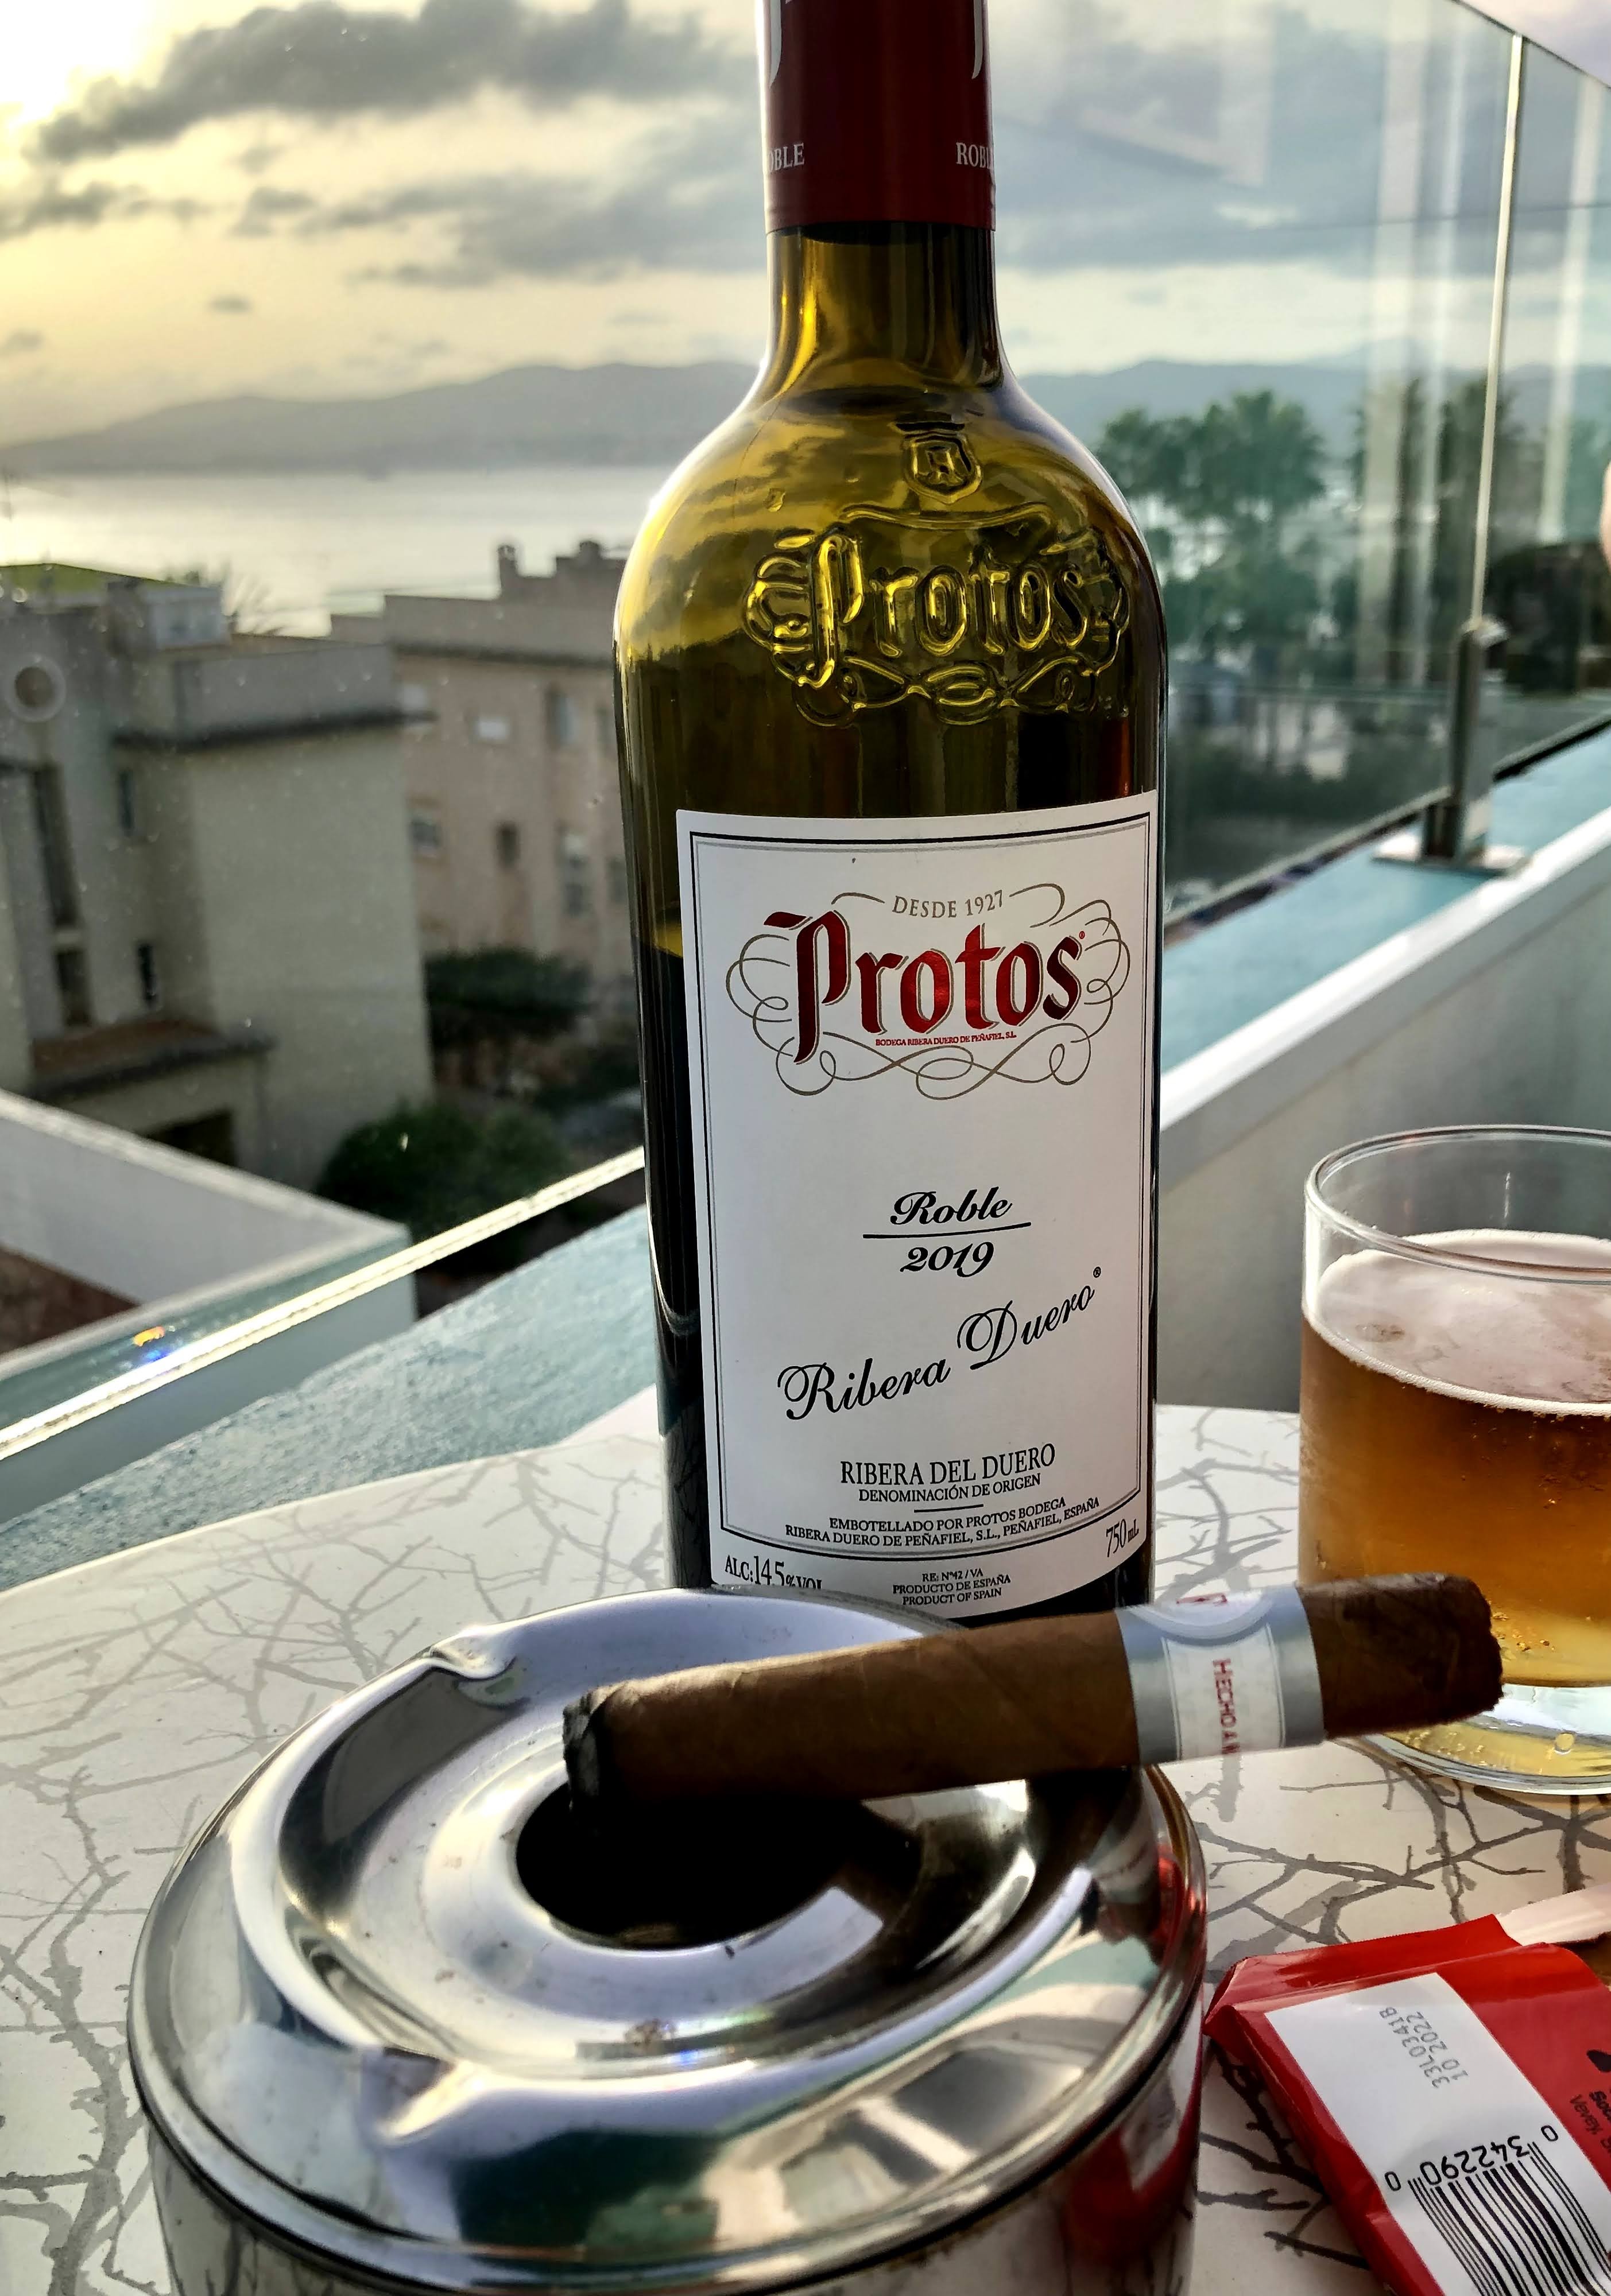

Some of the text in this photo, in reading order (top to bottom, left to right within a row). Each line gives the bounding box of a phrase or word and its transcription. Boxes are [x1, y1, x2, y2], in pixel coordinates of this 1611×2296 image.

[768, 142, 805, 172] OBLE
[775, 531, 1089, 689] Protos
[892, 889, 1002, 918] DESDE 1927
[908, 1037, 932, 1045] RIBERA
[934, 1036, 959, 1044] DUERO
[890, 1186, 1013, 1225] Roble
[900, 1241, 994, 1278] 2019
[777, 1358, 951, 1420] Ribera
[840, 1443, 1056, 1486] RIBERA DEL DUERO
[859, 1473, 1041, 1502] DENOMINACIÓN DE ORIGEN
[785, 1524, 831, 1542] RIBERA
[833, 1532, 880, 1546] DUERO
[882, 1535, 902, 1546] DE
[905, 1532, 973, 1546] PEÑAFIEL,
[1003, 1514, 1062, 1537] PEÑAFIEL,
[1064, 1496, 1100, 1521] ESPAÑA
[829, 1496, 1066, 1532] EMBOTELLADO POR PROTOS BODEGA
[893, 1574, 1011, 1594] PRODUCTO DE ESPAÑA
[903, 1588, 1002, 1605] PRODUCT OF SPAIN
[1213, 1658, 1237, 1728] HECHO
[1406, 2011, 1469, 2081] 10 2022
[1384, 2125, 1559, 2192] 0 342290 0
